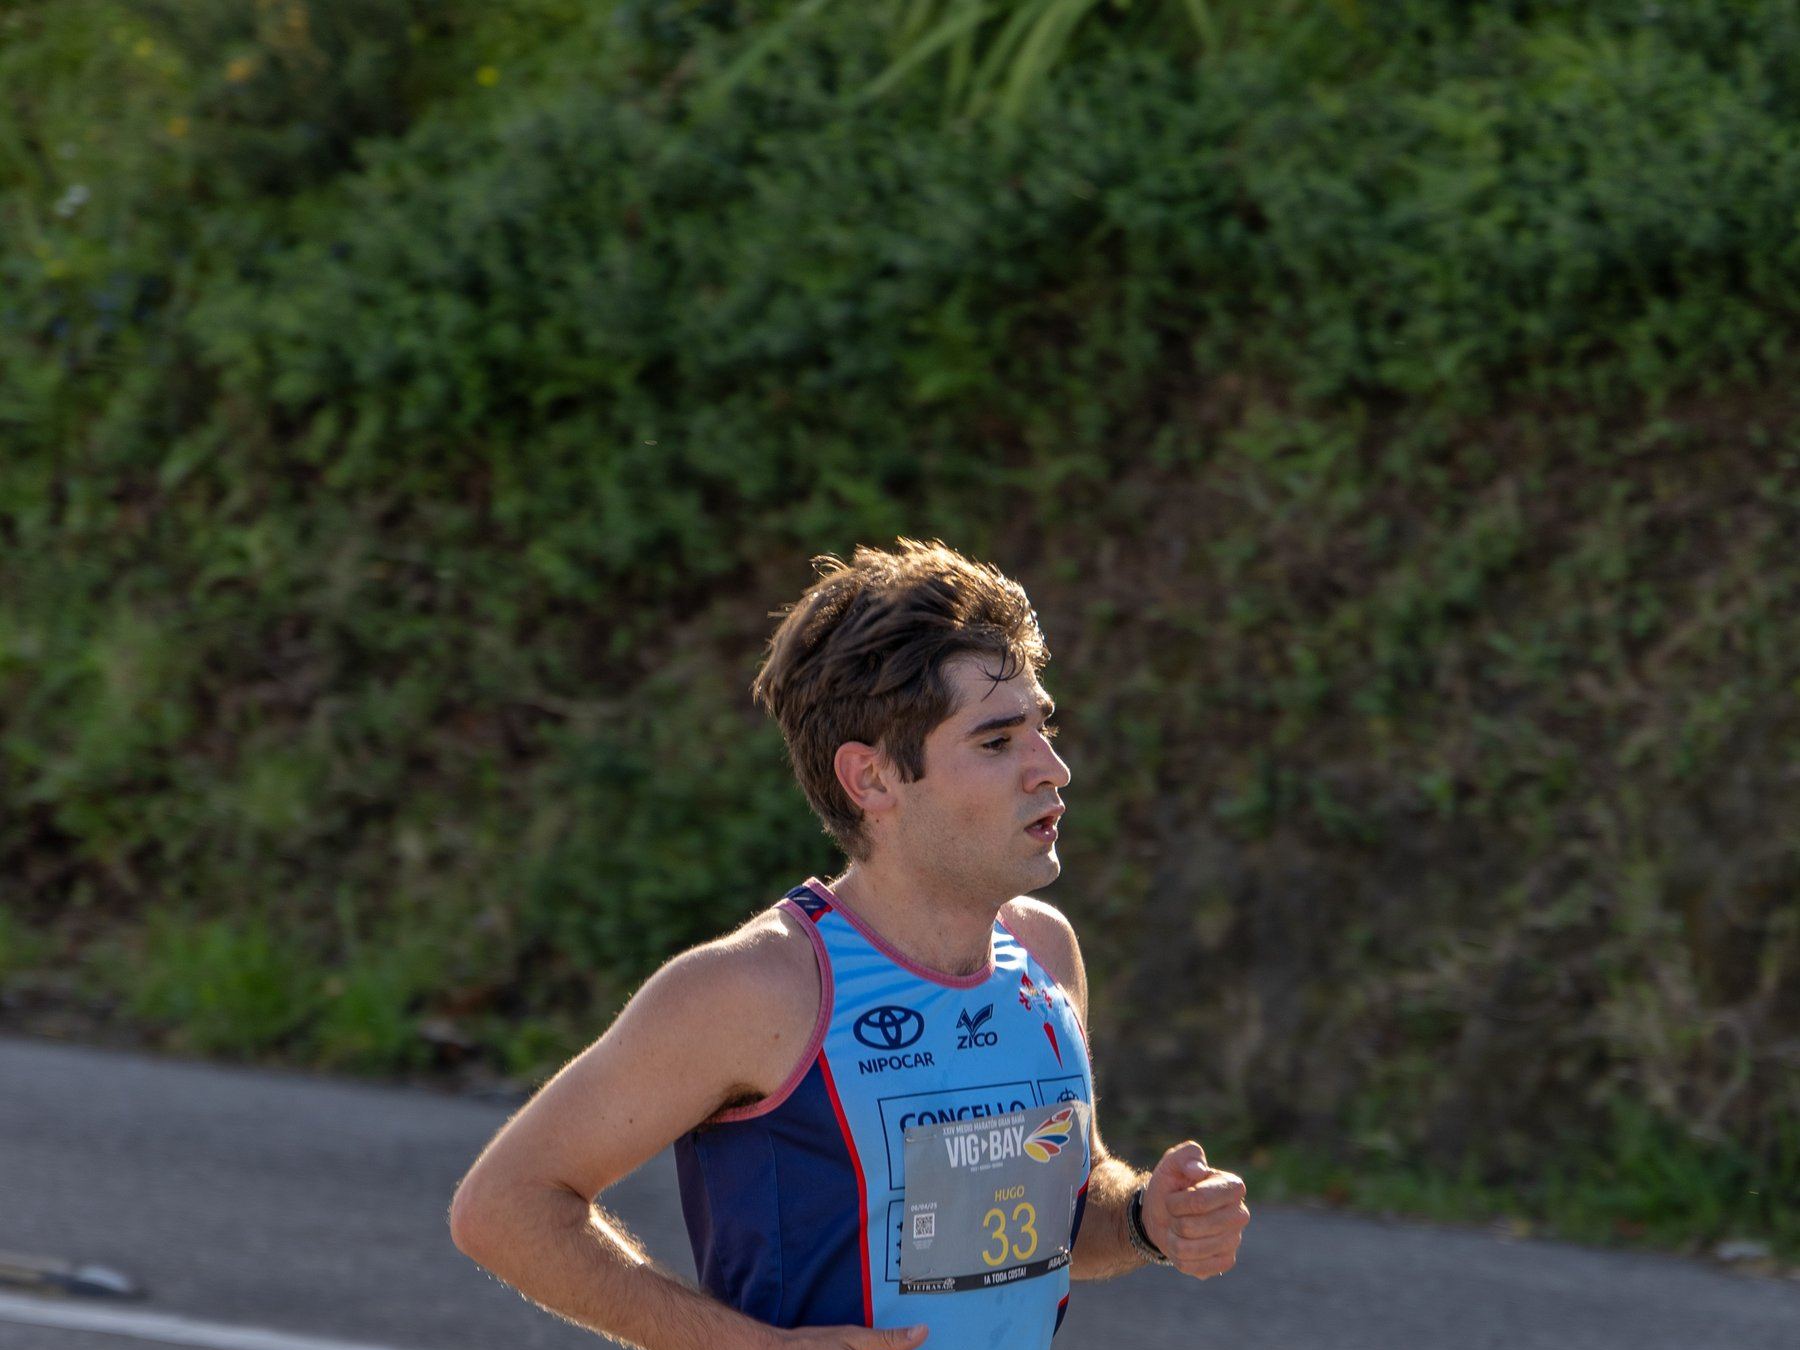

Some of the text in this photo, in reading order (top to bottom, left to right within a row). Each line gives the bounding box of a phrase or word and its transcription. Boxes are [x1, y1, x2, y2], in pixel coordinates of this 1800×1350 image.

[957, 1031, 998, 1050] ZICO
[858, 1051, 935, 1075] NIPOCAR
[994, 1184, 1025, 1202] HUGO
[982, 1201, 1038, 1267] 33
[992, 1271, 1008, 1284] TODA
